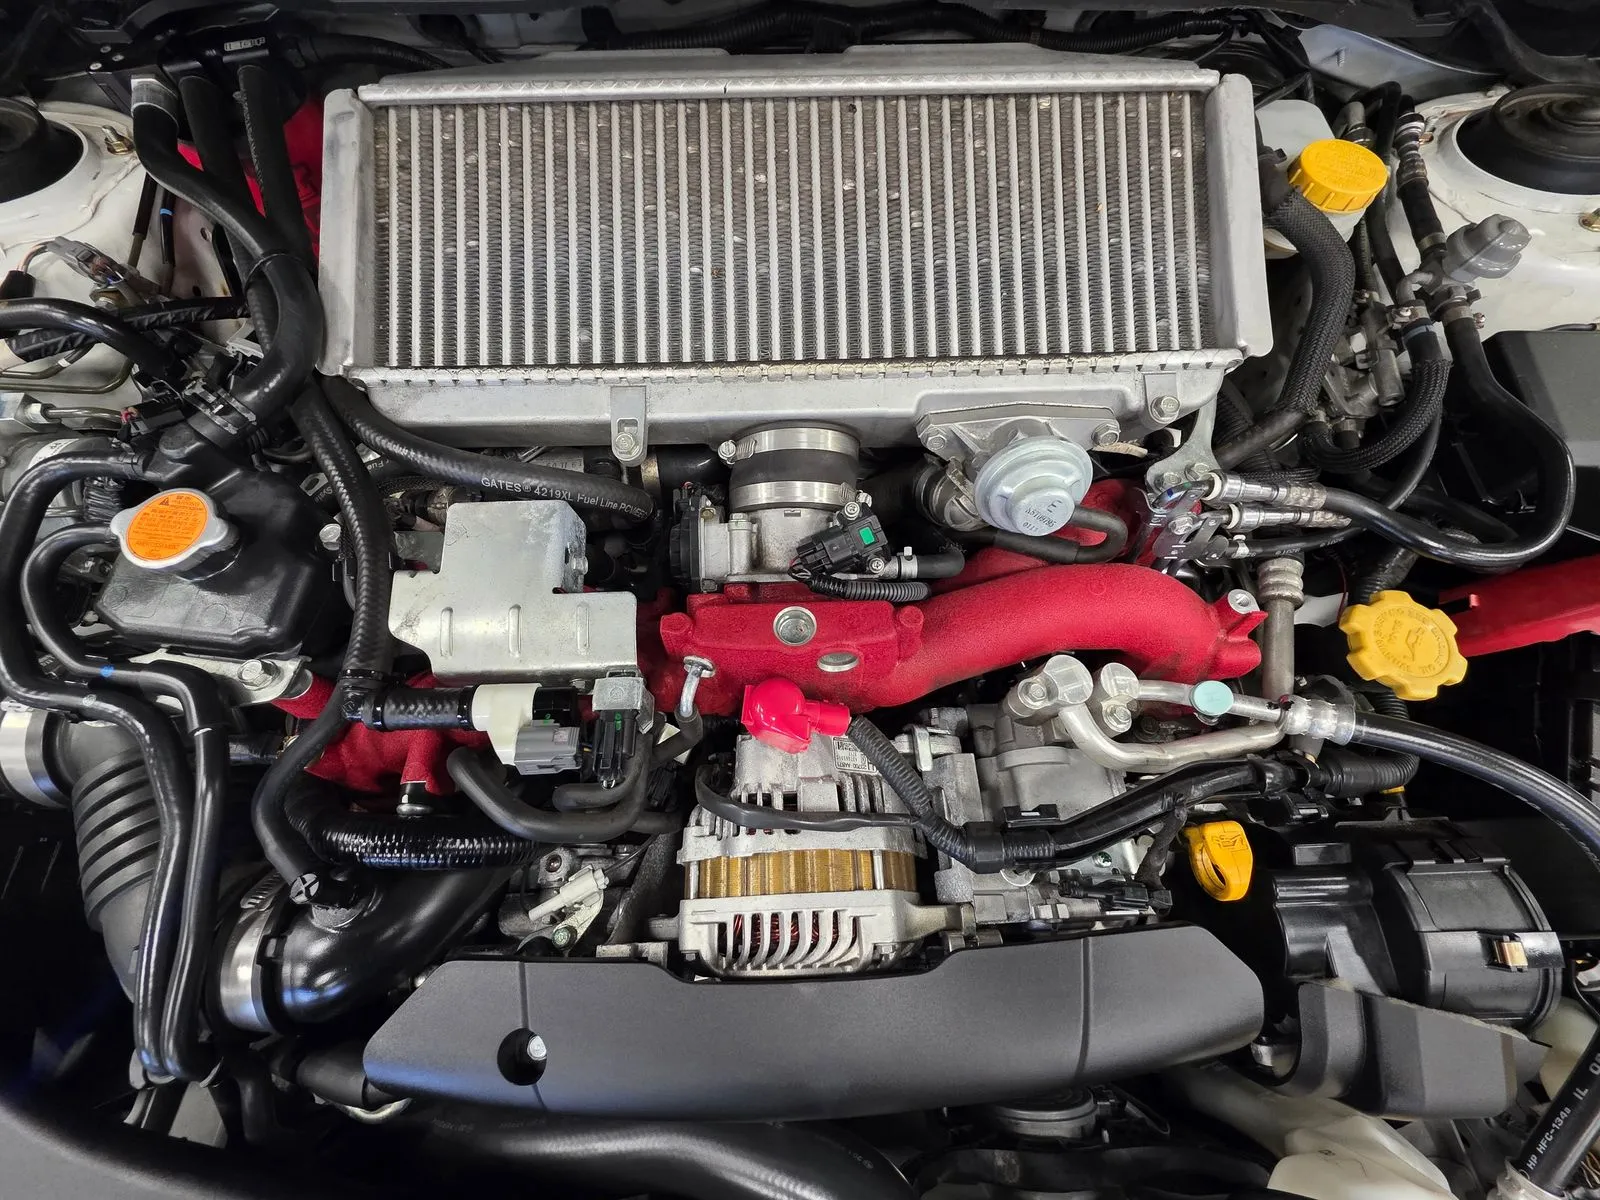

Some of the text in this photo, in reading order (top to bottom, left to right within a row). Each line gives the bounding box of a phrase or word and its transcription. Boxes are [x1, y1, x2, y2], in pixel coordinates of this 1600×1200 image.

[533, 485, 573, 501] 4219XL
[576, 493, 599, 506] Fuel
[600, 497, 618, 510] Line
[1047, 499, 1062, 513] E
[1526, 1153, 1538, 1171] HP
